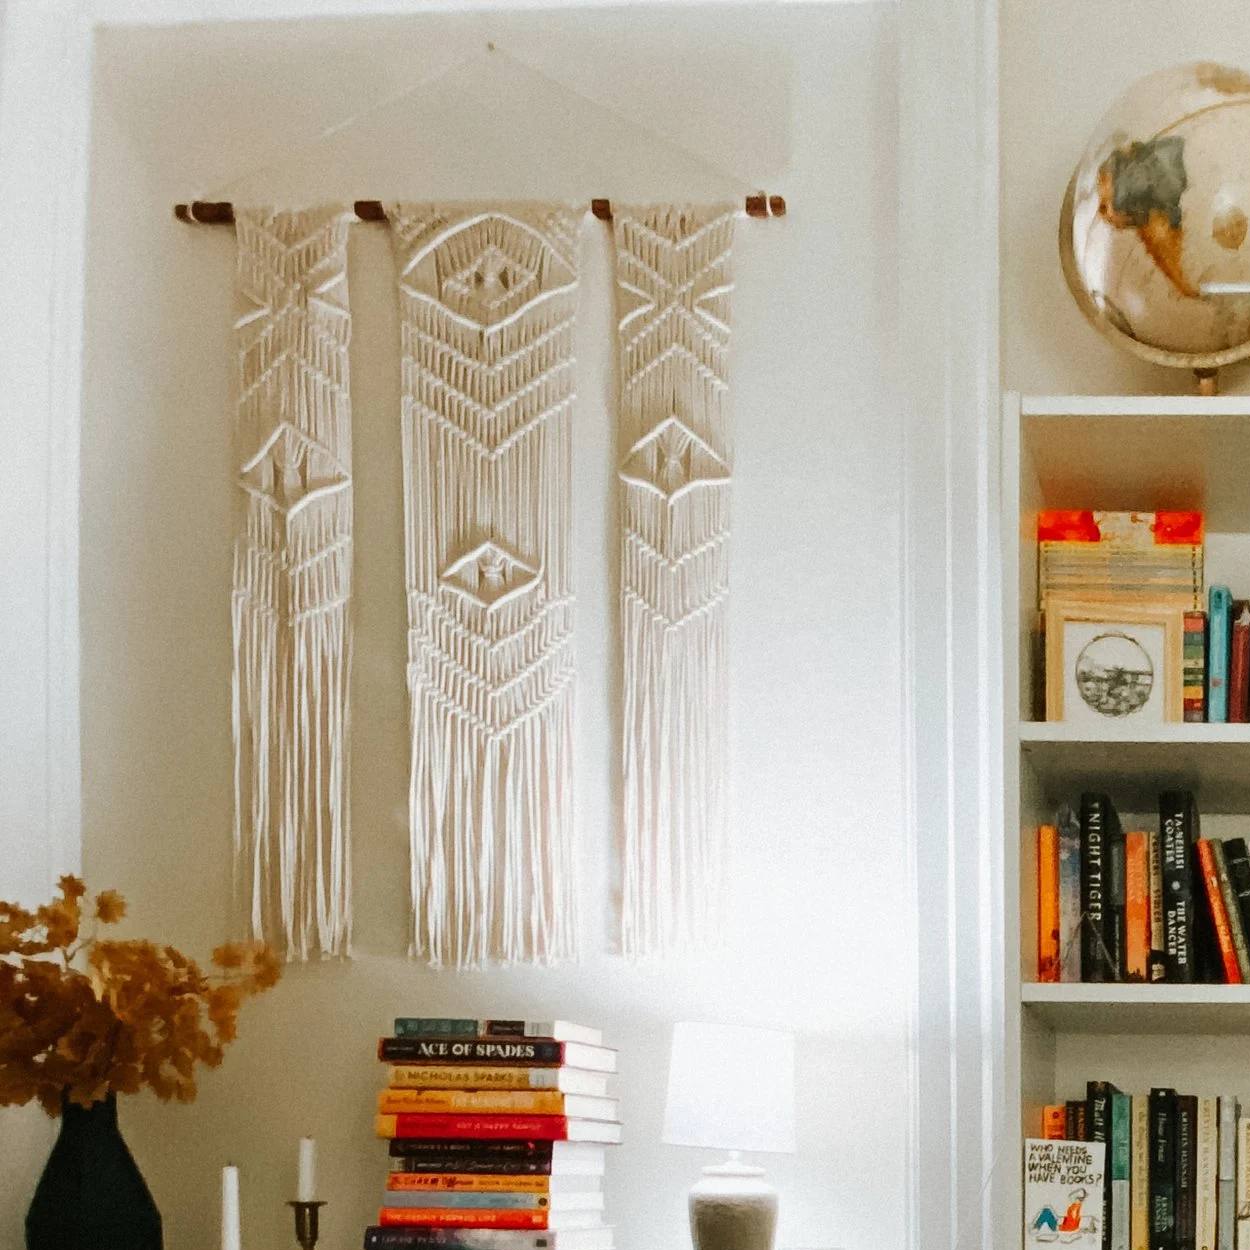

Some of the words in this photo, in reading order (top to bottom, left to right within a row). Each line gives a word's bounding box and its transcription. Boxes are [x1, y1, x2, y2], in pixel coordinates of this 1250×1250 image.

[1088, 813, 1101, 870] NIGHT
[1164, 819, 1175, 862] COATES
[1174, 812, 1184, 869] TA-NEHISI
[1089, 871, 1101, 921] TIGER
[1175, 901, 1185, 923] THE
[1168, 910, 1176, 955] DANCER
[1176, 926, 1187, 965] WATER
[417, 1042, 448, 1056] ACE
[452, 1042, 472, 1055] OF
[476, 1044, 535, 1058] SPADES
[407, 1070, 470, 1083] NICHOLAS
[474, 1070, 513, 1083] SPARKS
[1028, 1154, 1037, 1162] A
[1038, 1153, 1093, 1165] VALENTINE
[1030, 1144, 1053, 1153] WHO
[1057, 1146, 1088, 1155] NEEDS
[1028, 1162, 1061, 1175] WHEN
[1066, 1165, 1087, 1174] YOU
[1028, 1174, 1056, 1183] HAVE
[1060, 1174, 1103, 1185] BOOKS?
